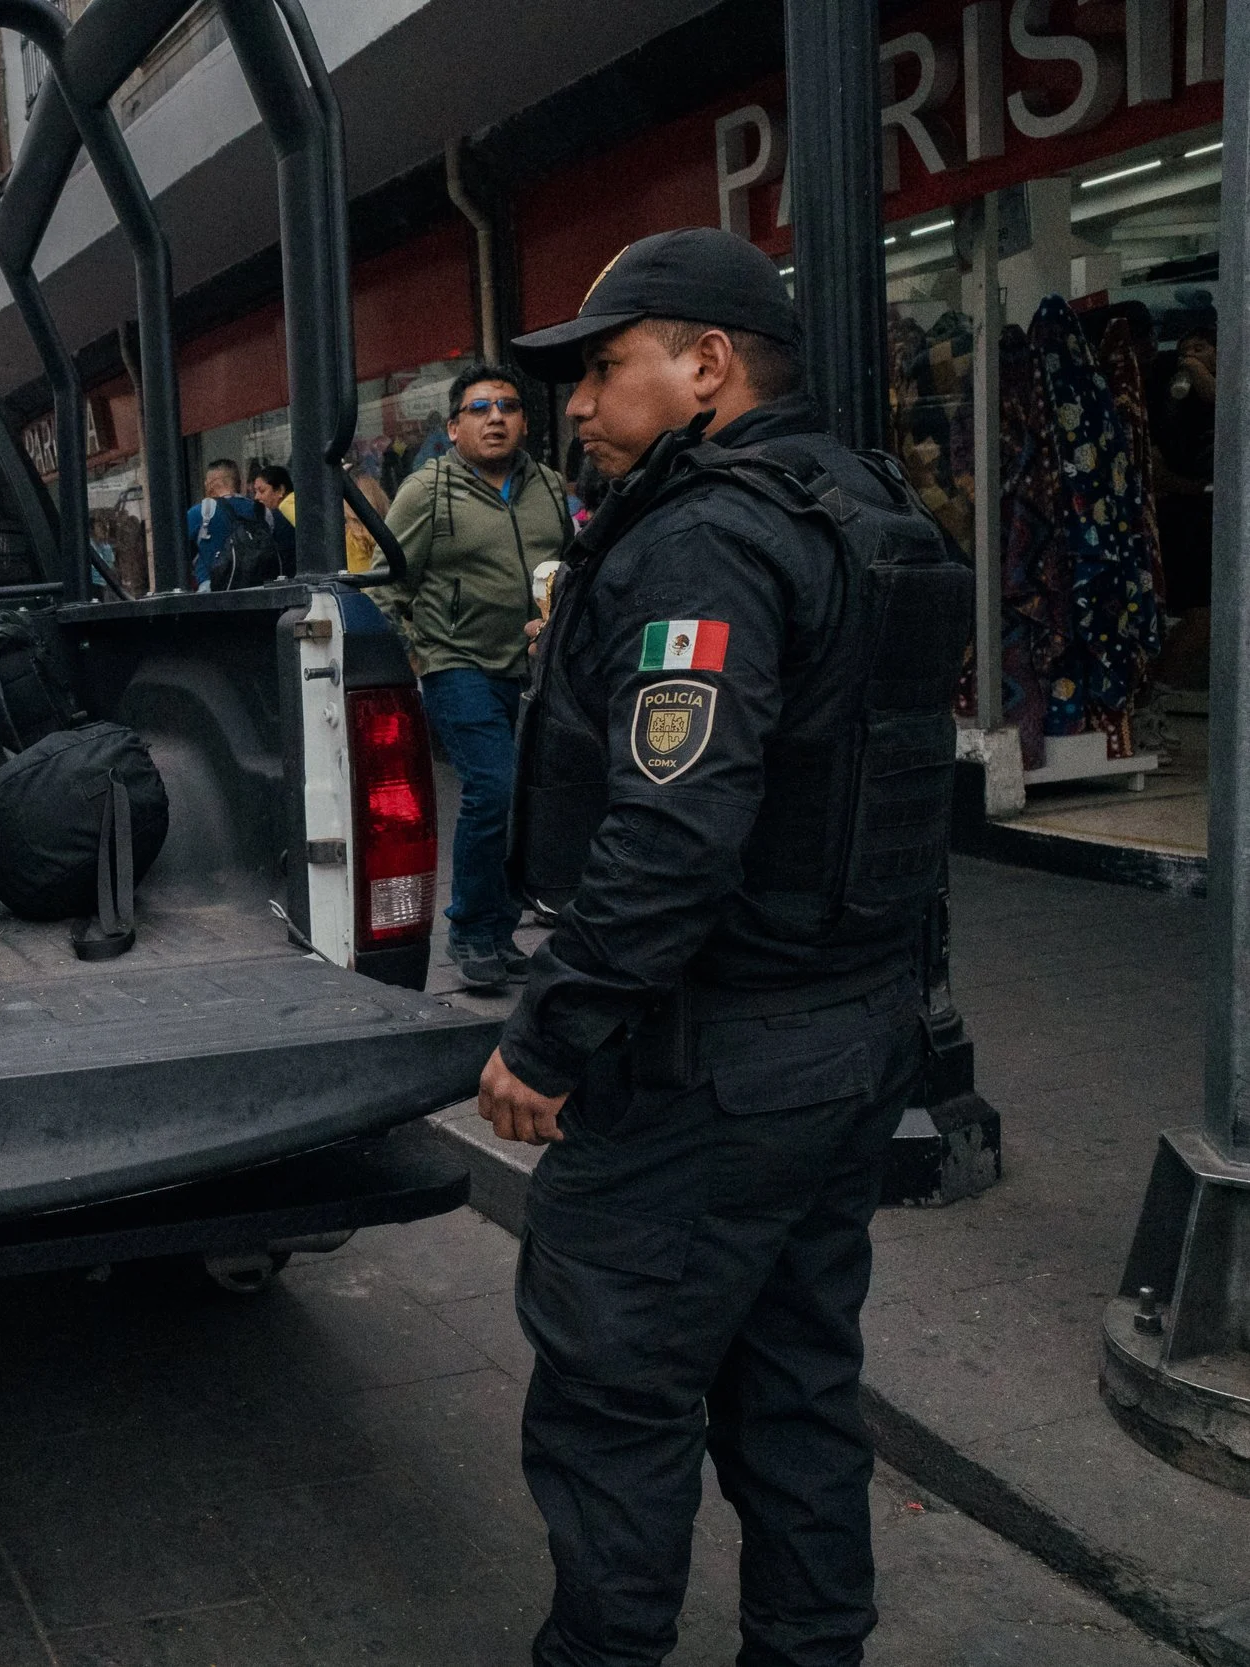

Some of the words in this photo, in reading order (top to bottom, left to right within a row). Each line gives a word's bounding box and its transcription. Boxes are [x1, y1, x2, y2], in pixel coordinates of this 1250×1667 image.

[715, 0, 1224, 233] PRISI
[645, 690, 703, 708] POLICÍA
[648, 758, 677, 768] CDMX
